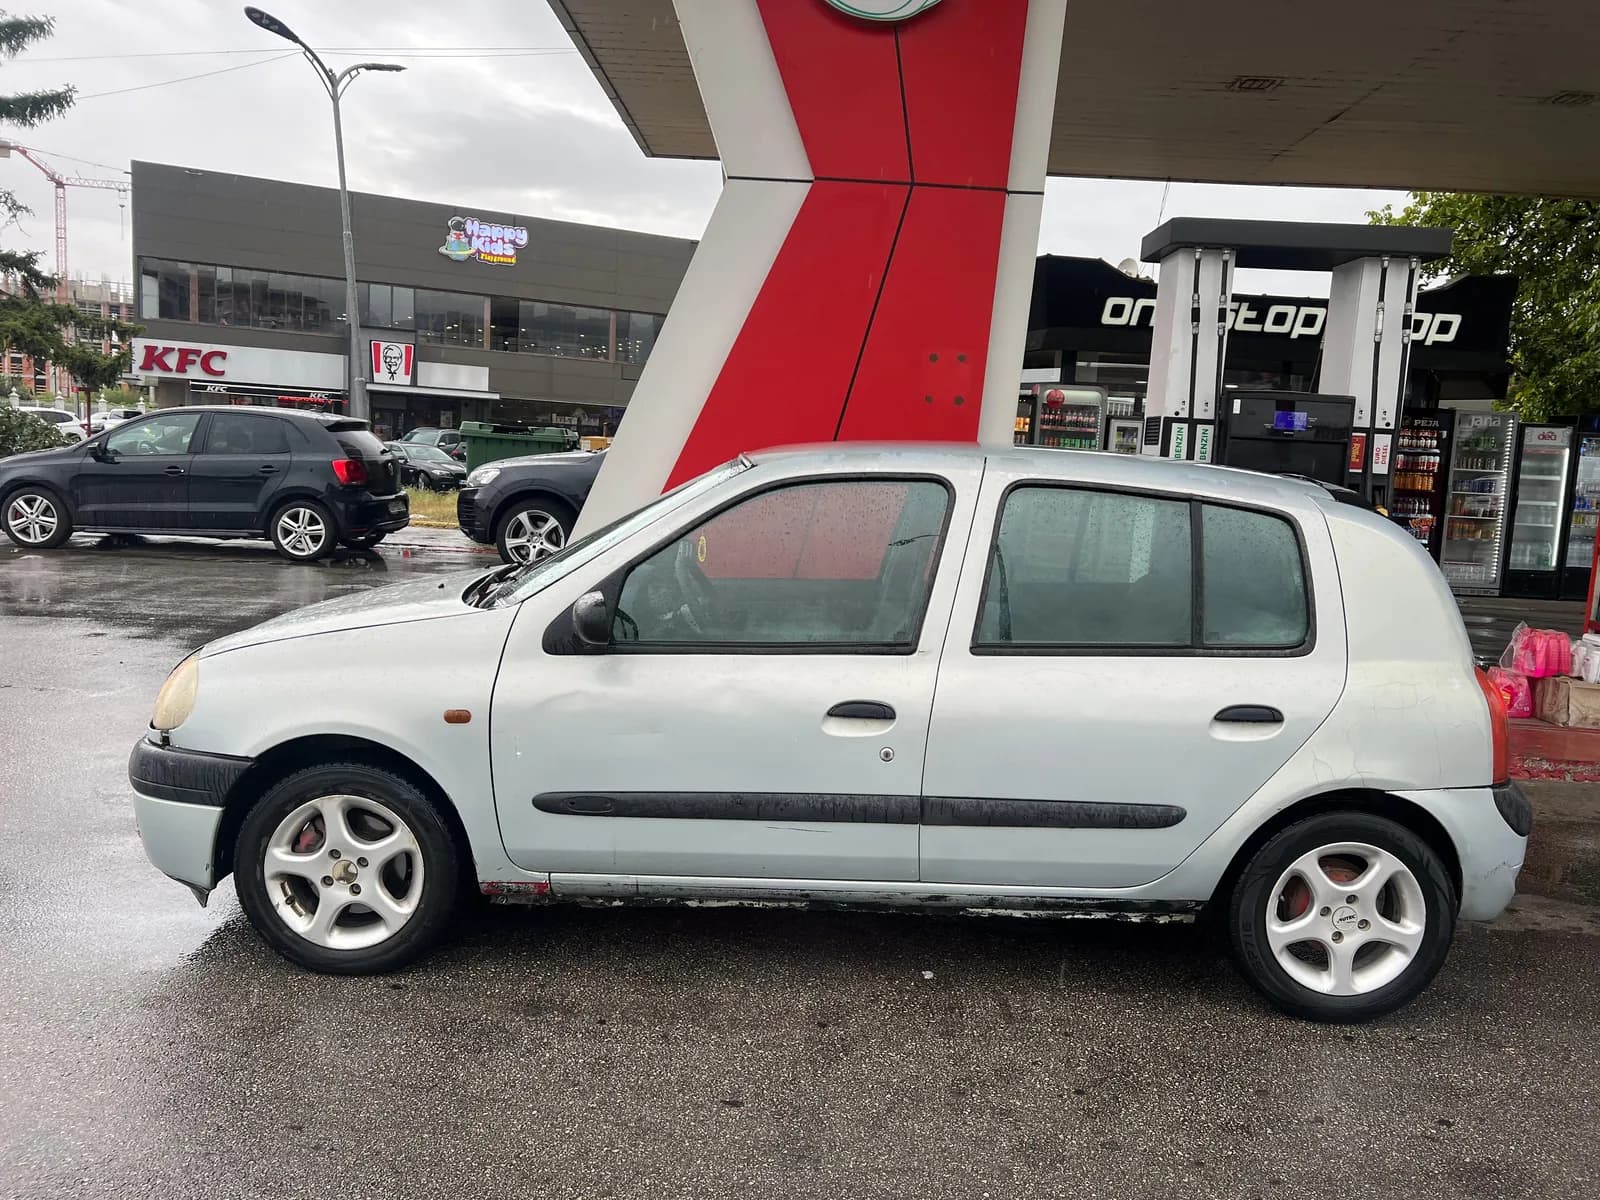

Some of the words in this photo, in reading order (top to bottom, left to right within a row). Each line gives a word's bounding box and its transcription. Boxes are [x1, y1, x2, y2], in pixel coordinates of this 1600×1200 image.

[465, 219, 528, 245] Happy
[472, 237, 515, 255] Kids
[1101, 297, 1157, 326] on
[1411, 312, 1462, 345] op
[139, 345, 228, 376] KFC
[206, 385, 228, 393] KFC
[309, 392, 329, 400] KFC
[1174, 427, 1185, 460] BENZIN
[1200, 428, 1209, 461] BENZIN
